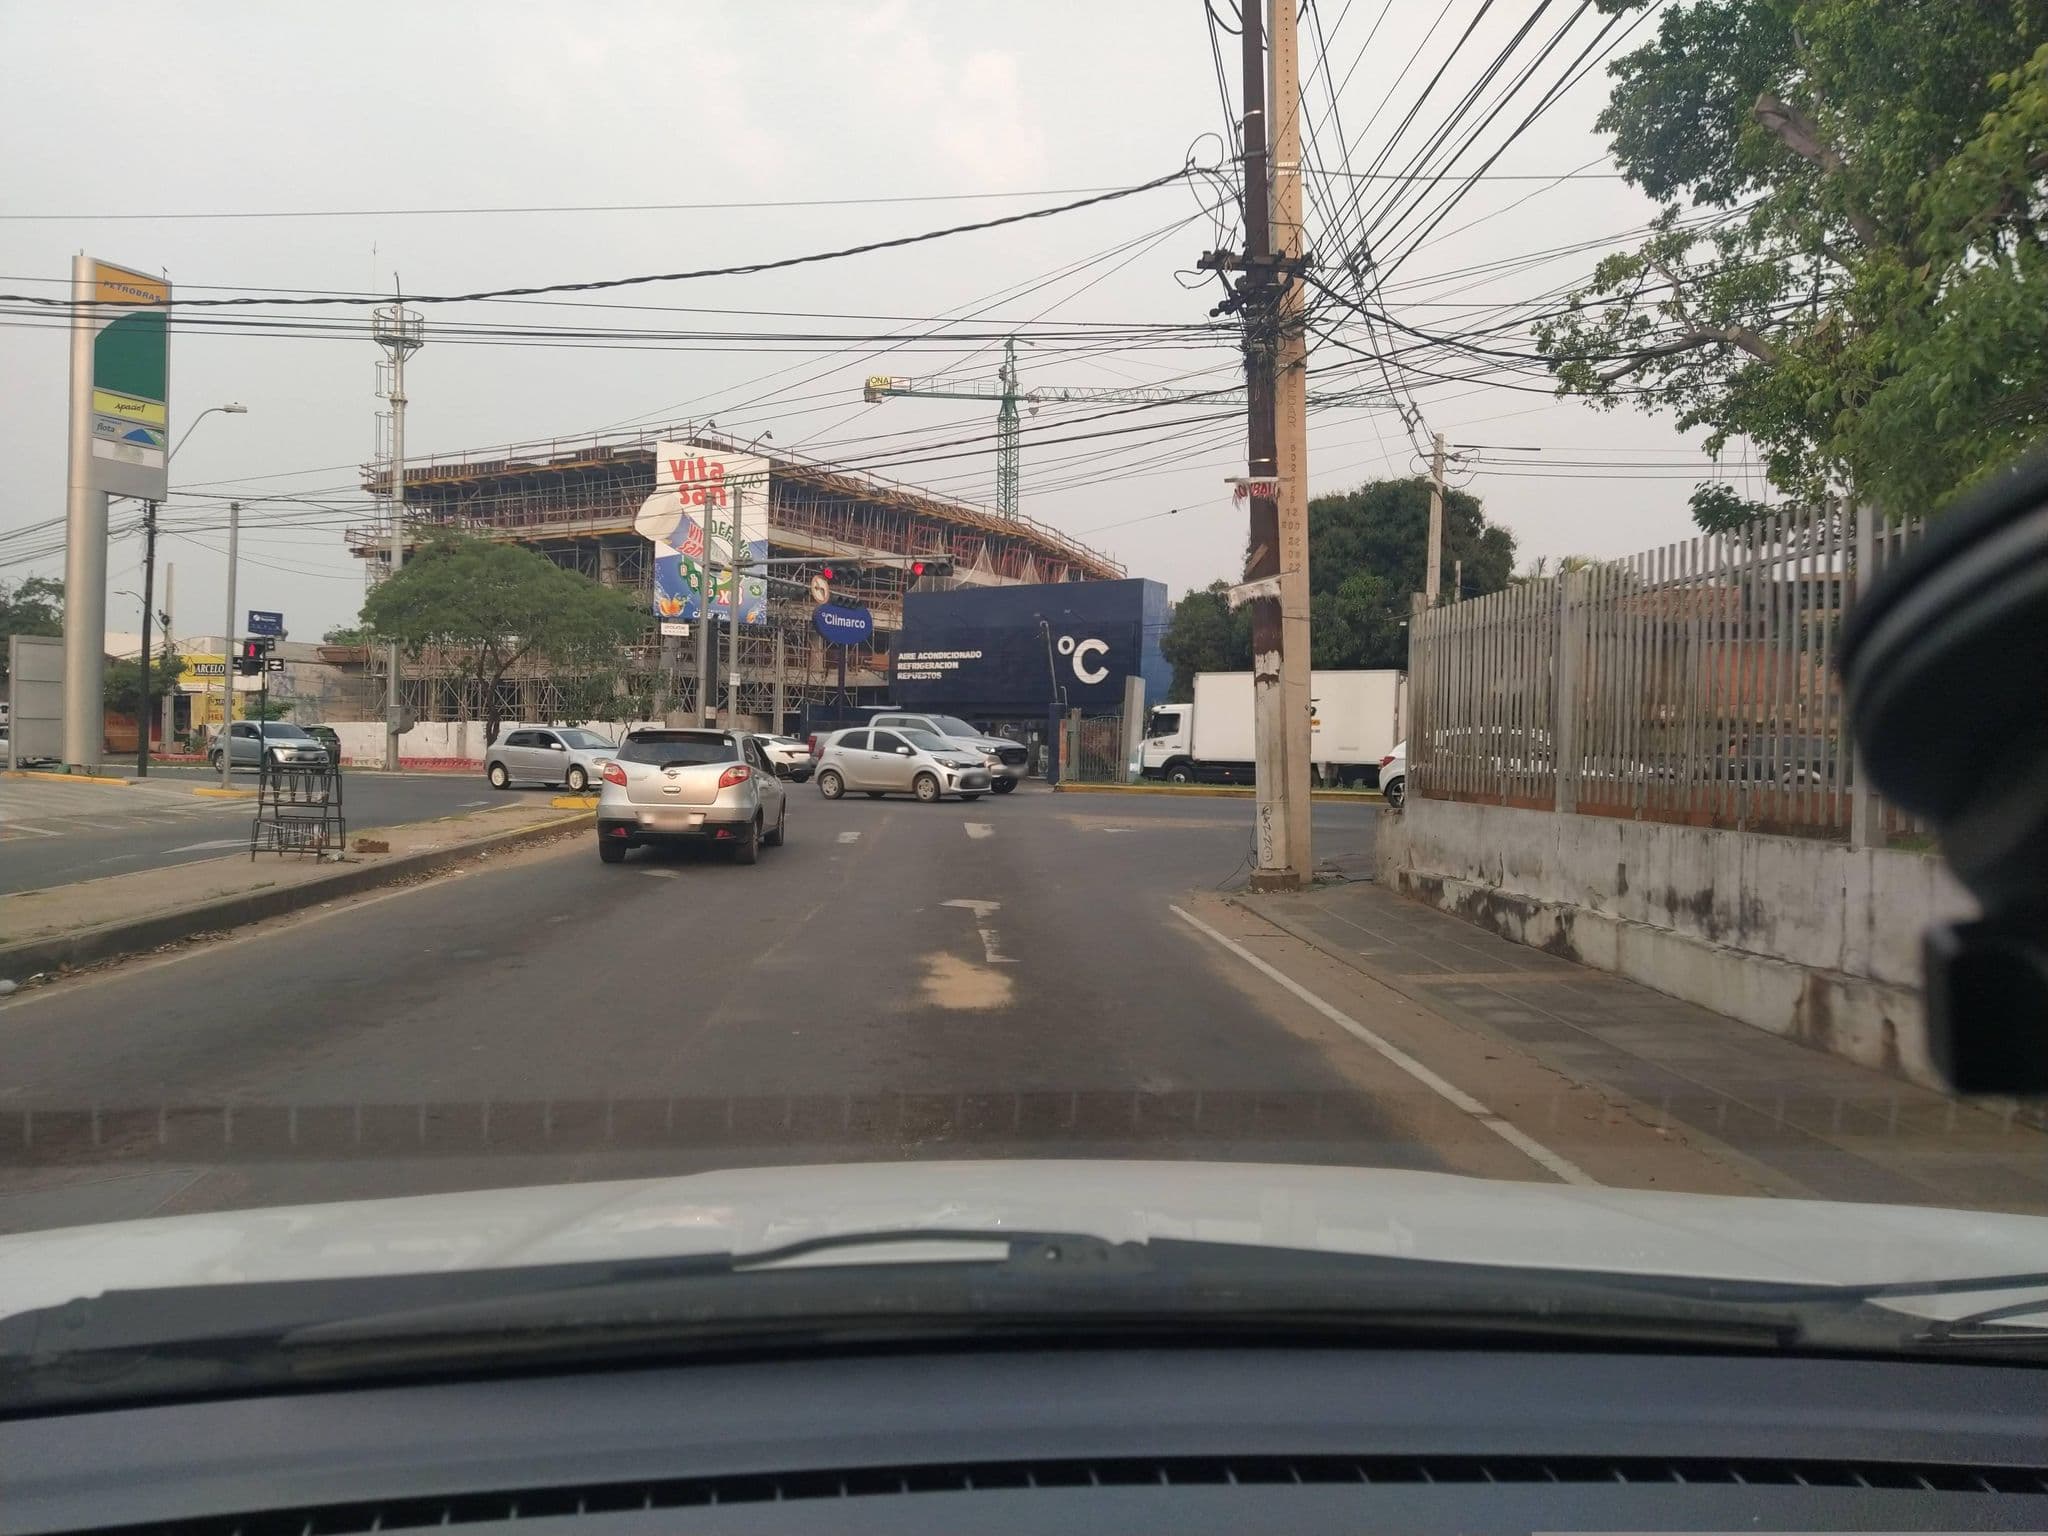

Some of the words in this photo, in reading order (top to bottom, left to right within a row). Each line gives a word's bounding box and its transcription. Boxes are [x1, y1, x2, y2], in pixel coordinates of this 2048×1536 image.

[669, 455, 725, 484] Vita
[679, 484, 727, 506] san
[898, 652, 917, 660] AIRE
[917, 650, 983, 660] ACONDICIONADO
[897, 671, 942, 680] REPUESTOS
